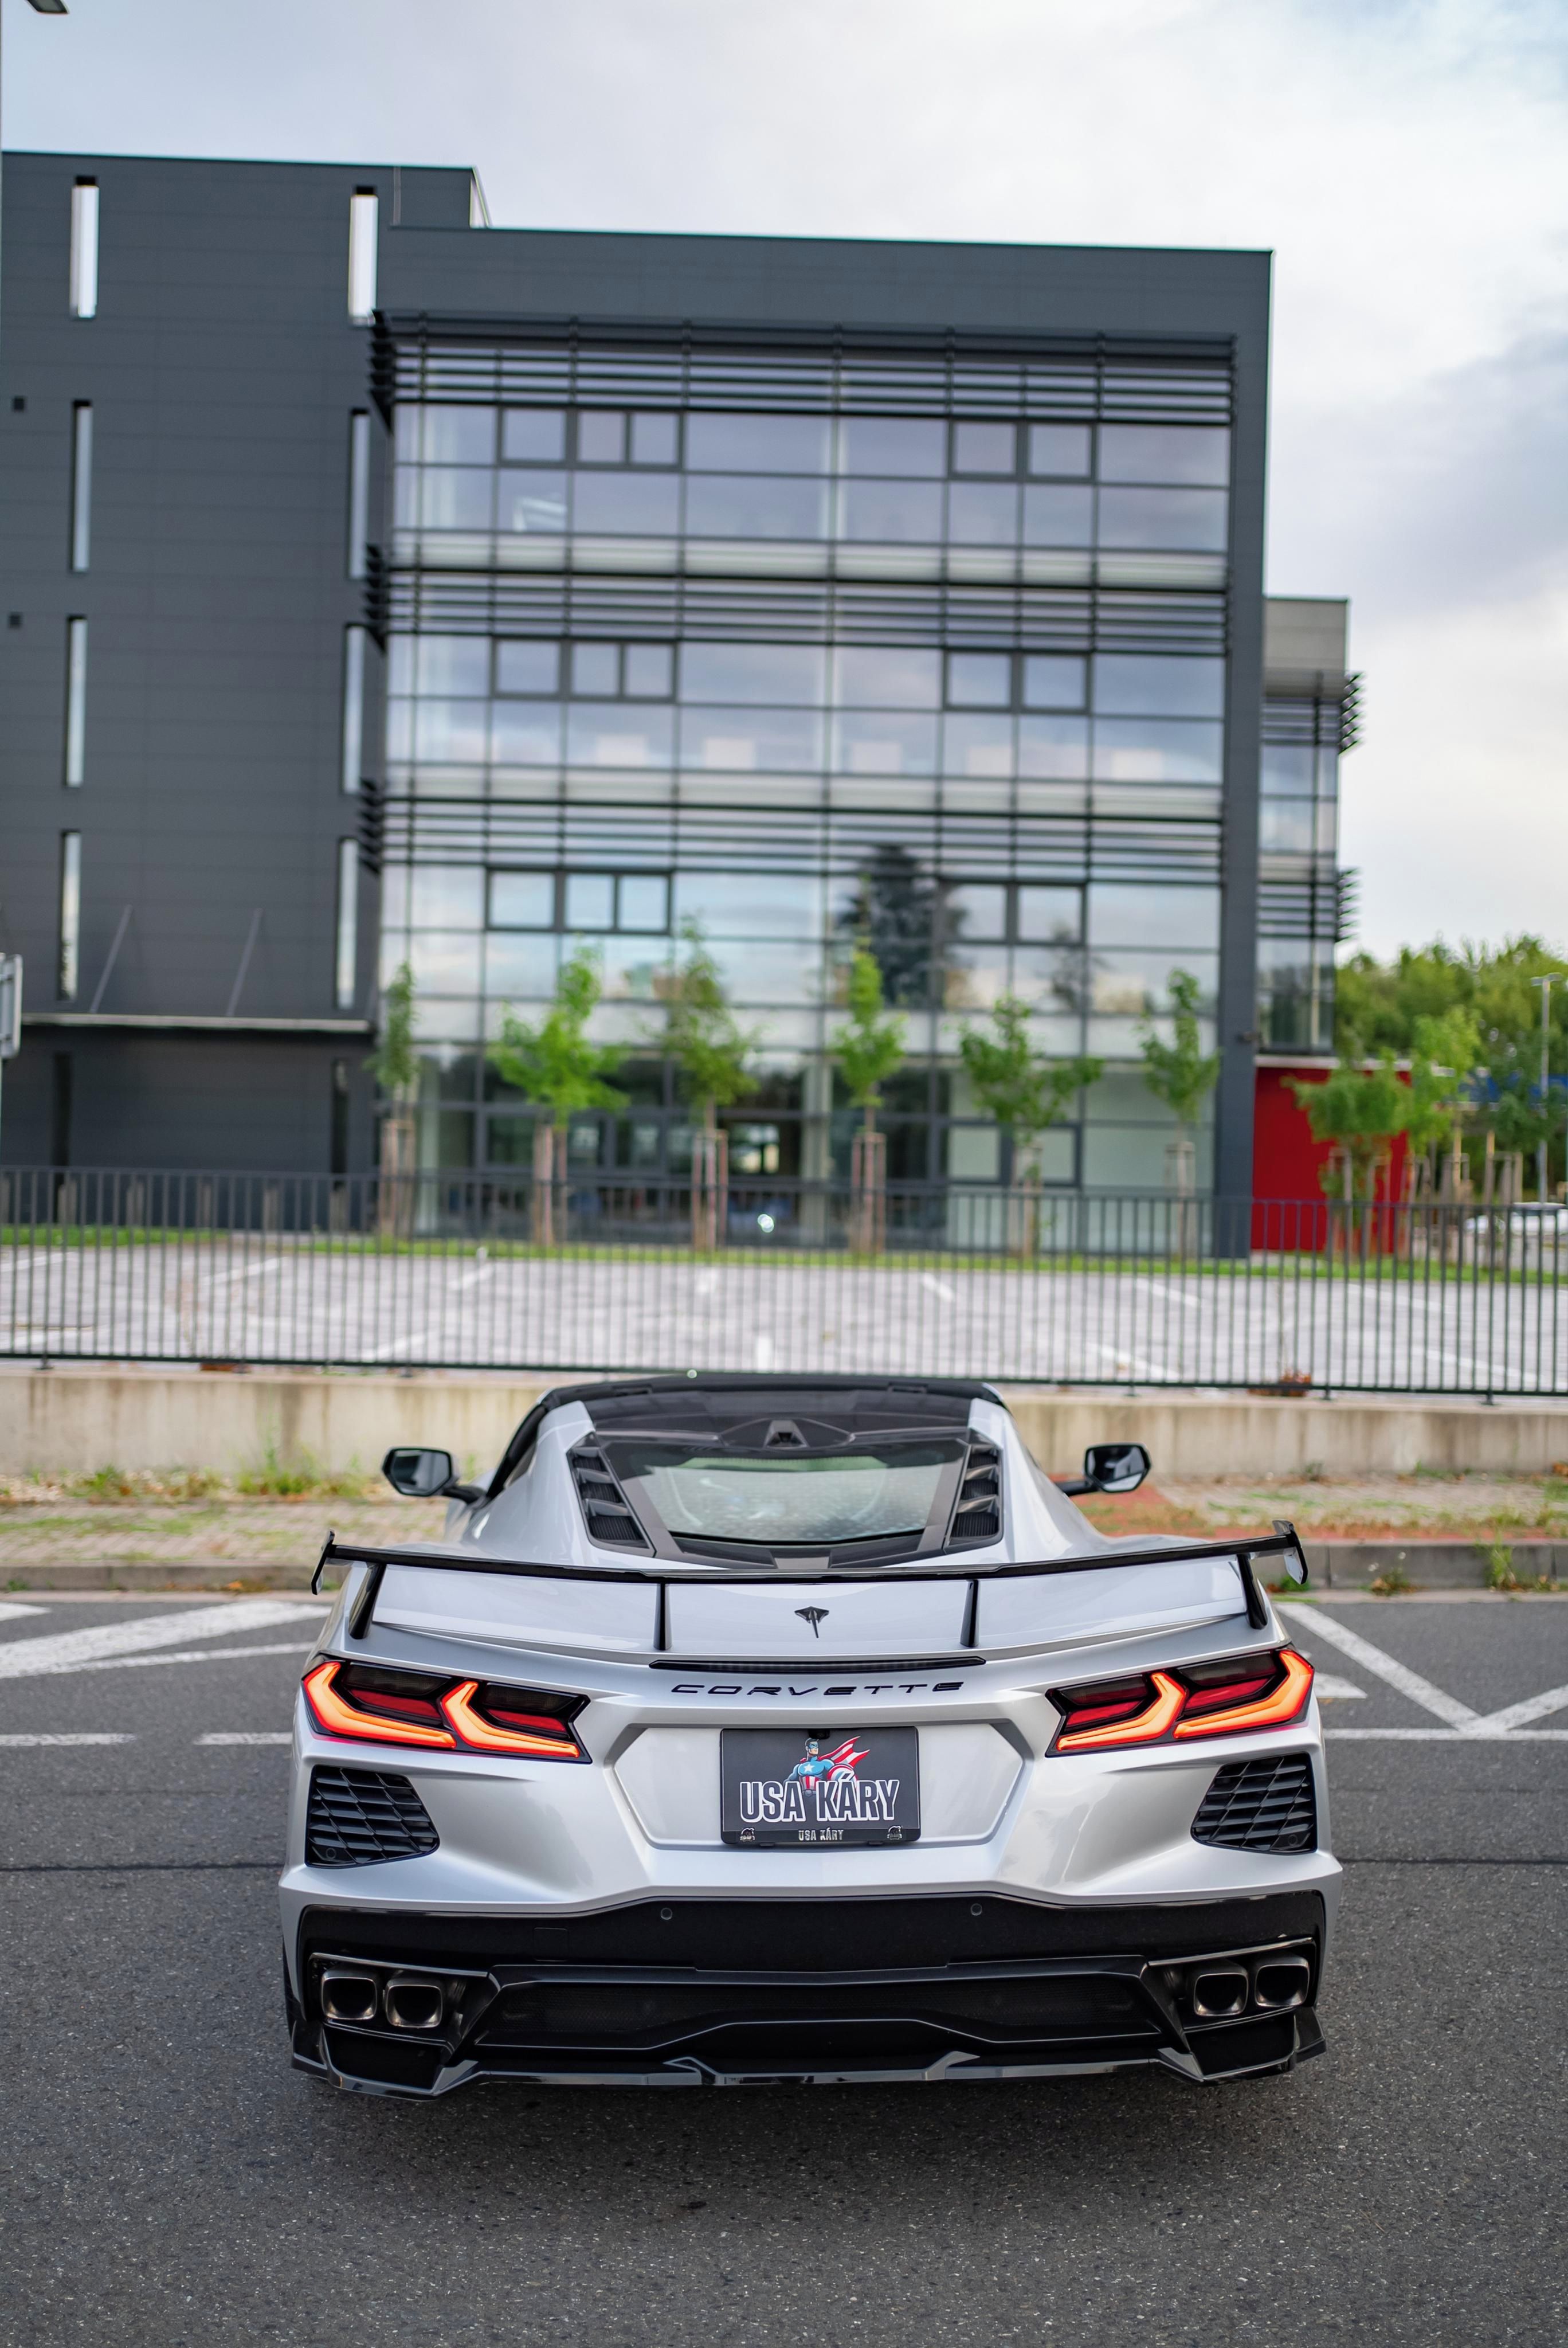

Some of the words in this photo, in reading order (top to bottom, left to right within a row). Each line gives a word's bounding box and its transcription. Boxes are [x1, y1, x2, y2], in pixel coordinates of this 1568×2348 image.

[671, 1681, 965, 1695] CORVETTE
[740, 1781, 806, 1822] USA
[816, 1770, 900, 1821] KÁRY
[798, 1830, 817, 1841] USA
[820, 1827, 844, 1841] KÁRY
